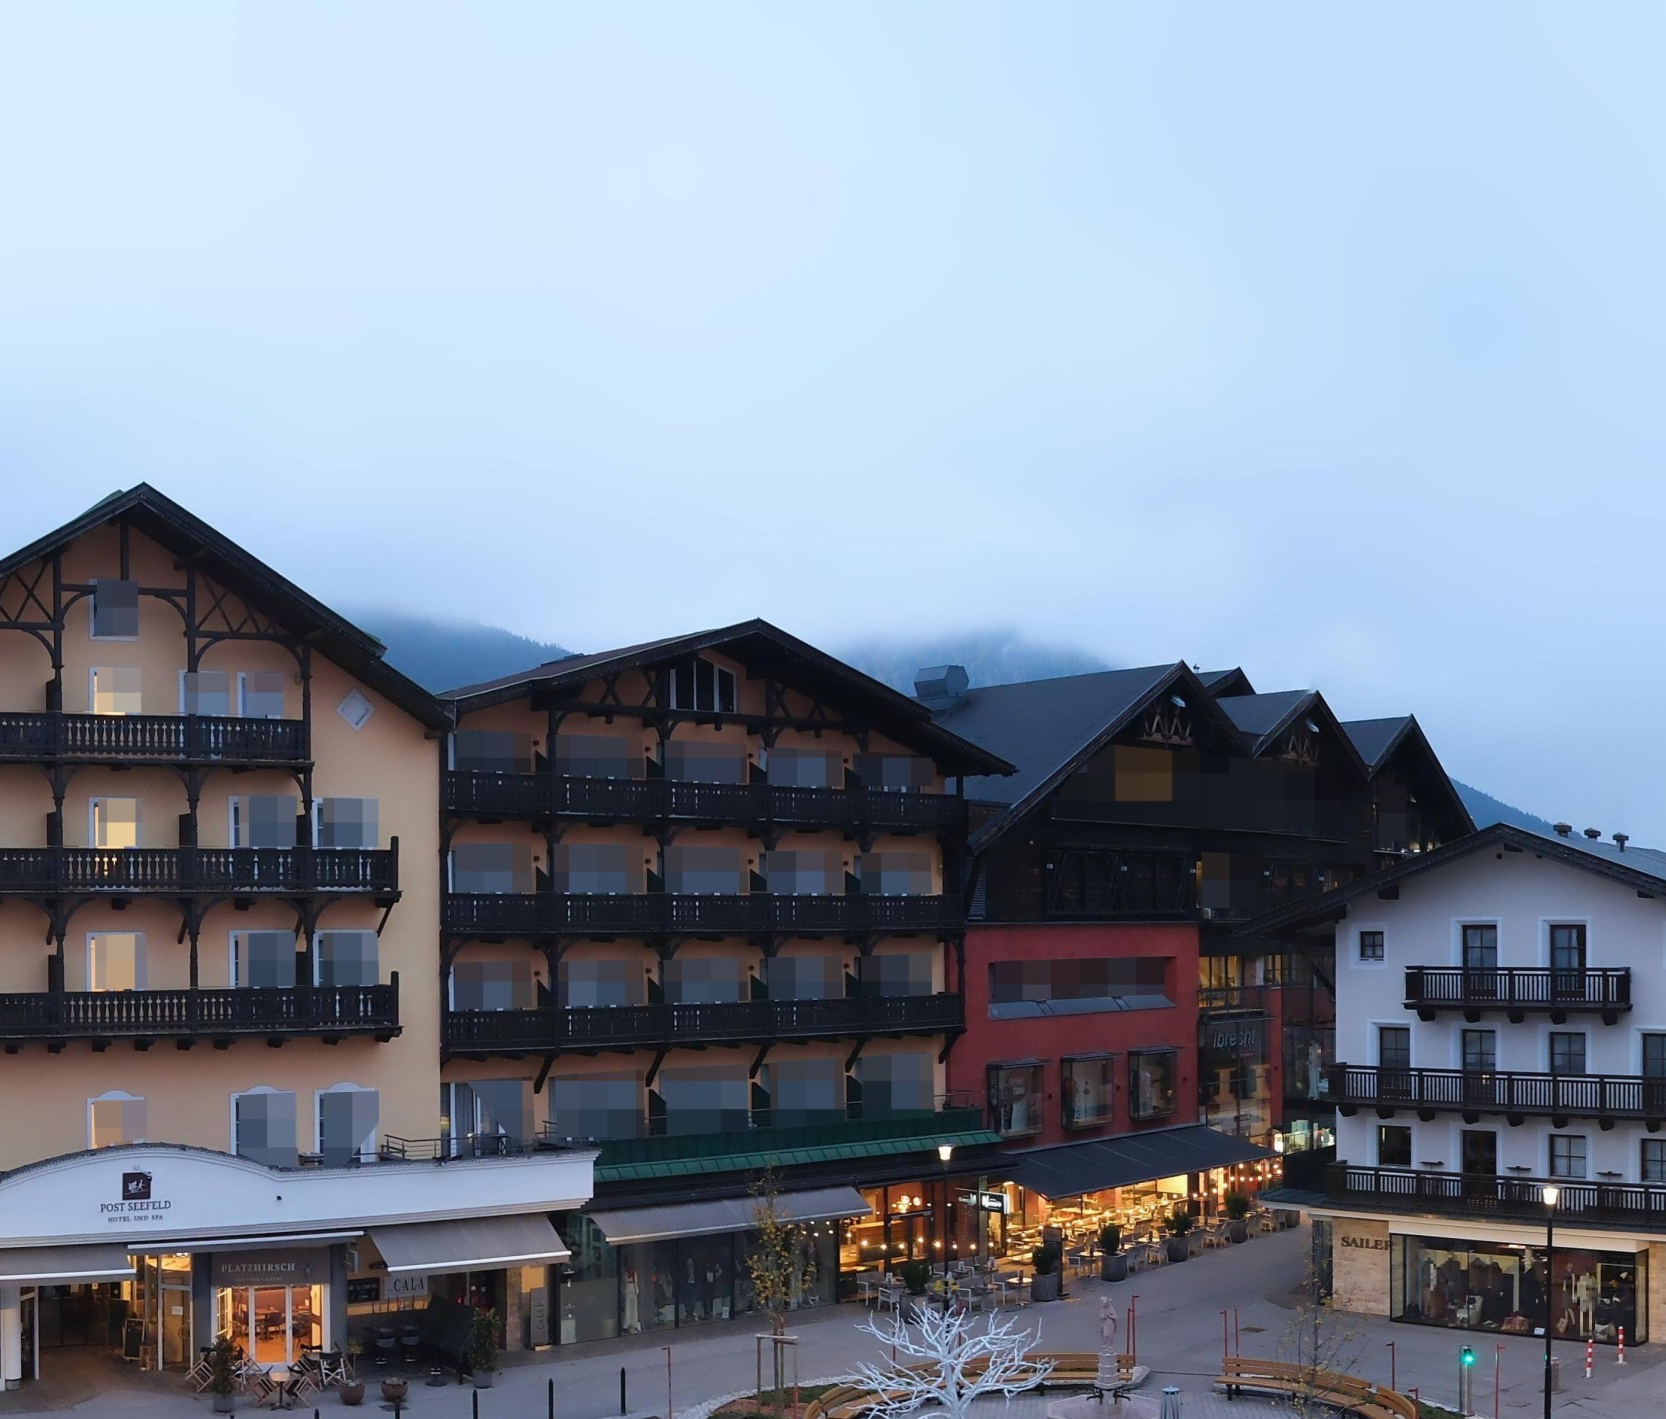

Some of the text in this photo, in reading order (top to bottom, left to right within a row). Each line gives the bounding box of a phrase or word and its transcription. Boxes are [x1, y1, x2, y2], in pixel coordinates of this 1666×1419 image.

[100, 1200, 172, 1213] POST SEEFELD
[221, 1262, 295, 1273] PLATZHIRSCH
